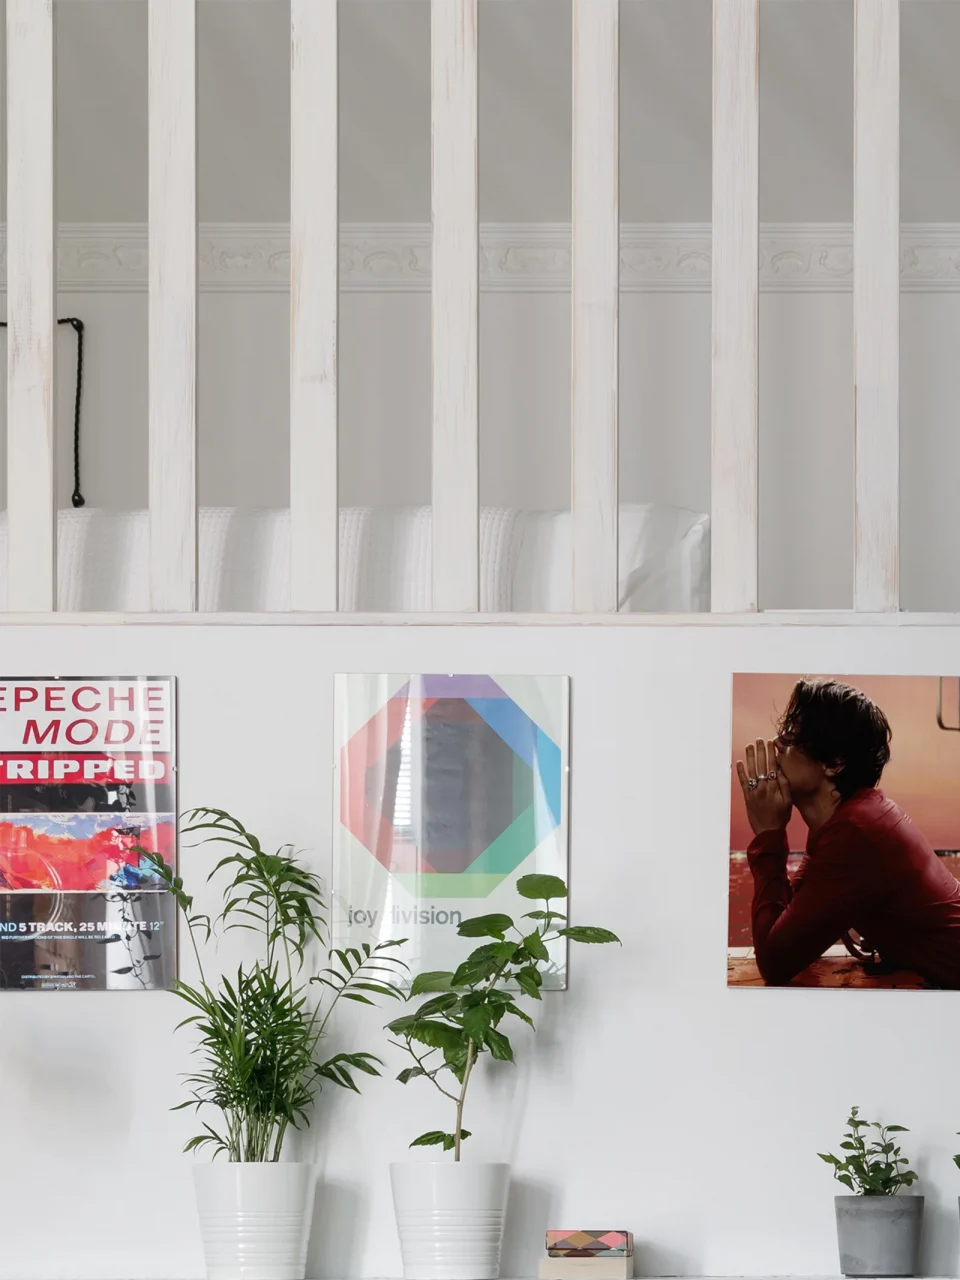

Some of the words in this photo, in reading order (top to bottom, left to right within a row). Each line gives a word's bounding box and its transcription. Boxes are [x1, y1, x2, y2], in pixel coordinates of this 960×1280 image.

[0, 686, 165, 712] PECHE
[22, 719, 165, 745] MODE
[0, 759, 166, 780] RIPPED
[19, 922, 27, 932] 5
[28, 922, 77, 934] TRACK,
[79, 922, 95, 932] 25
[347, 904, 379, 929] joy
[386, 904, 463, 925] ivision
